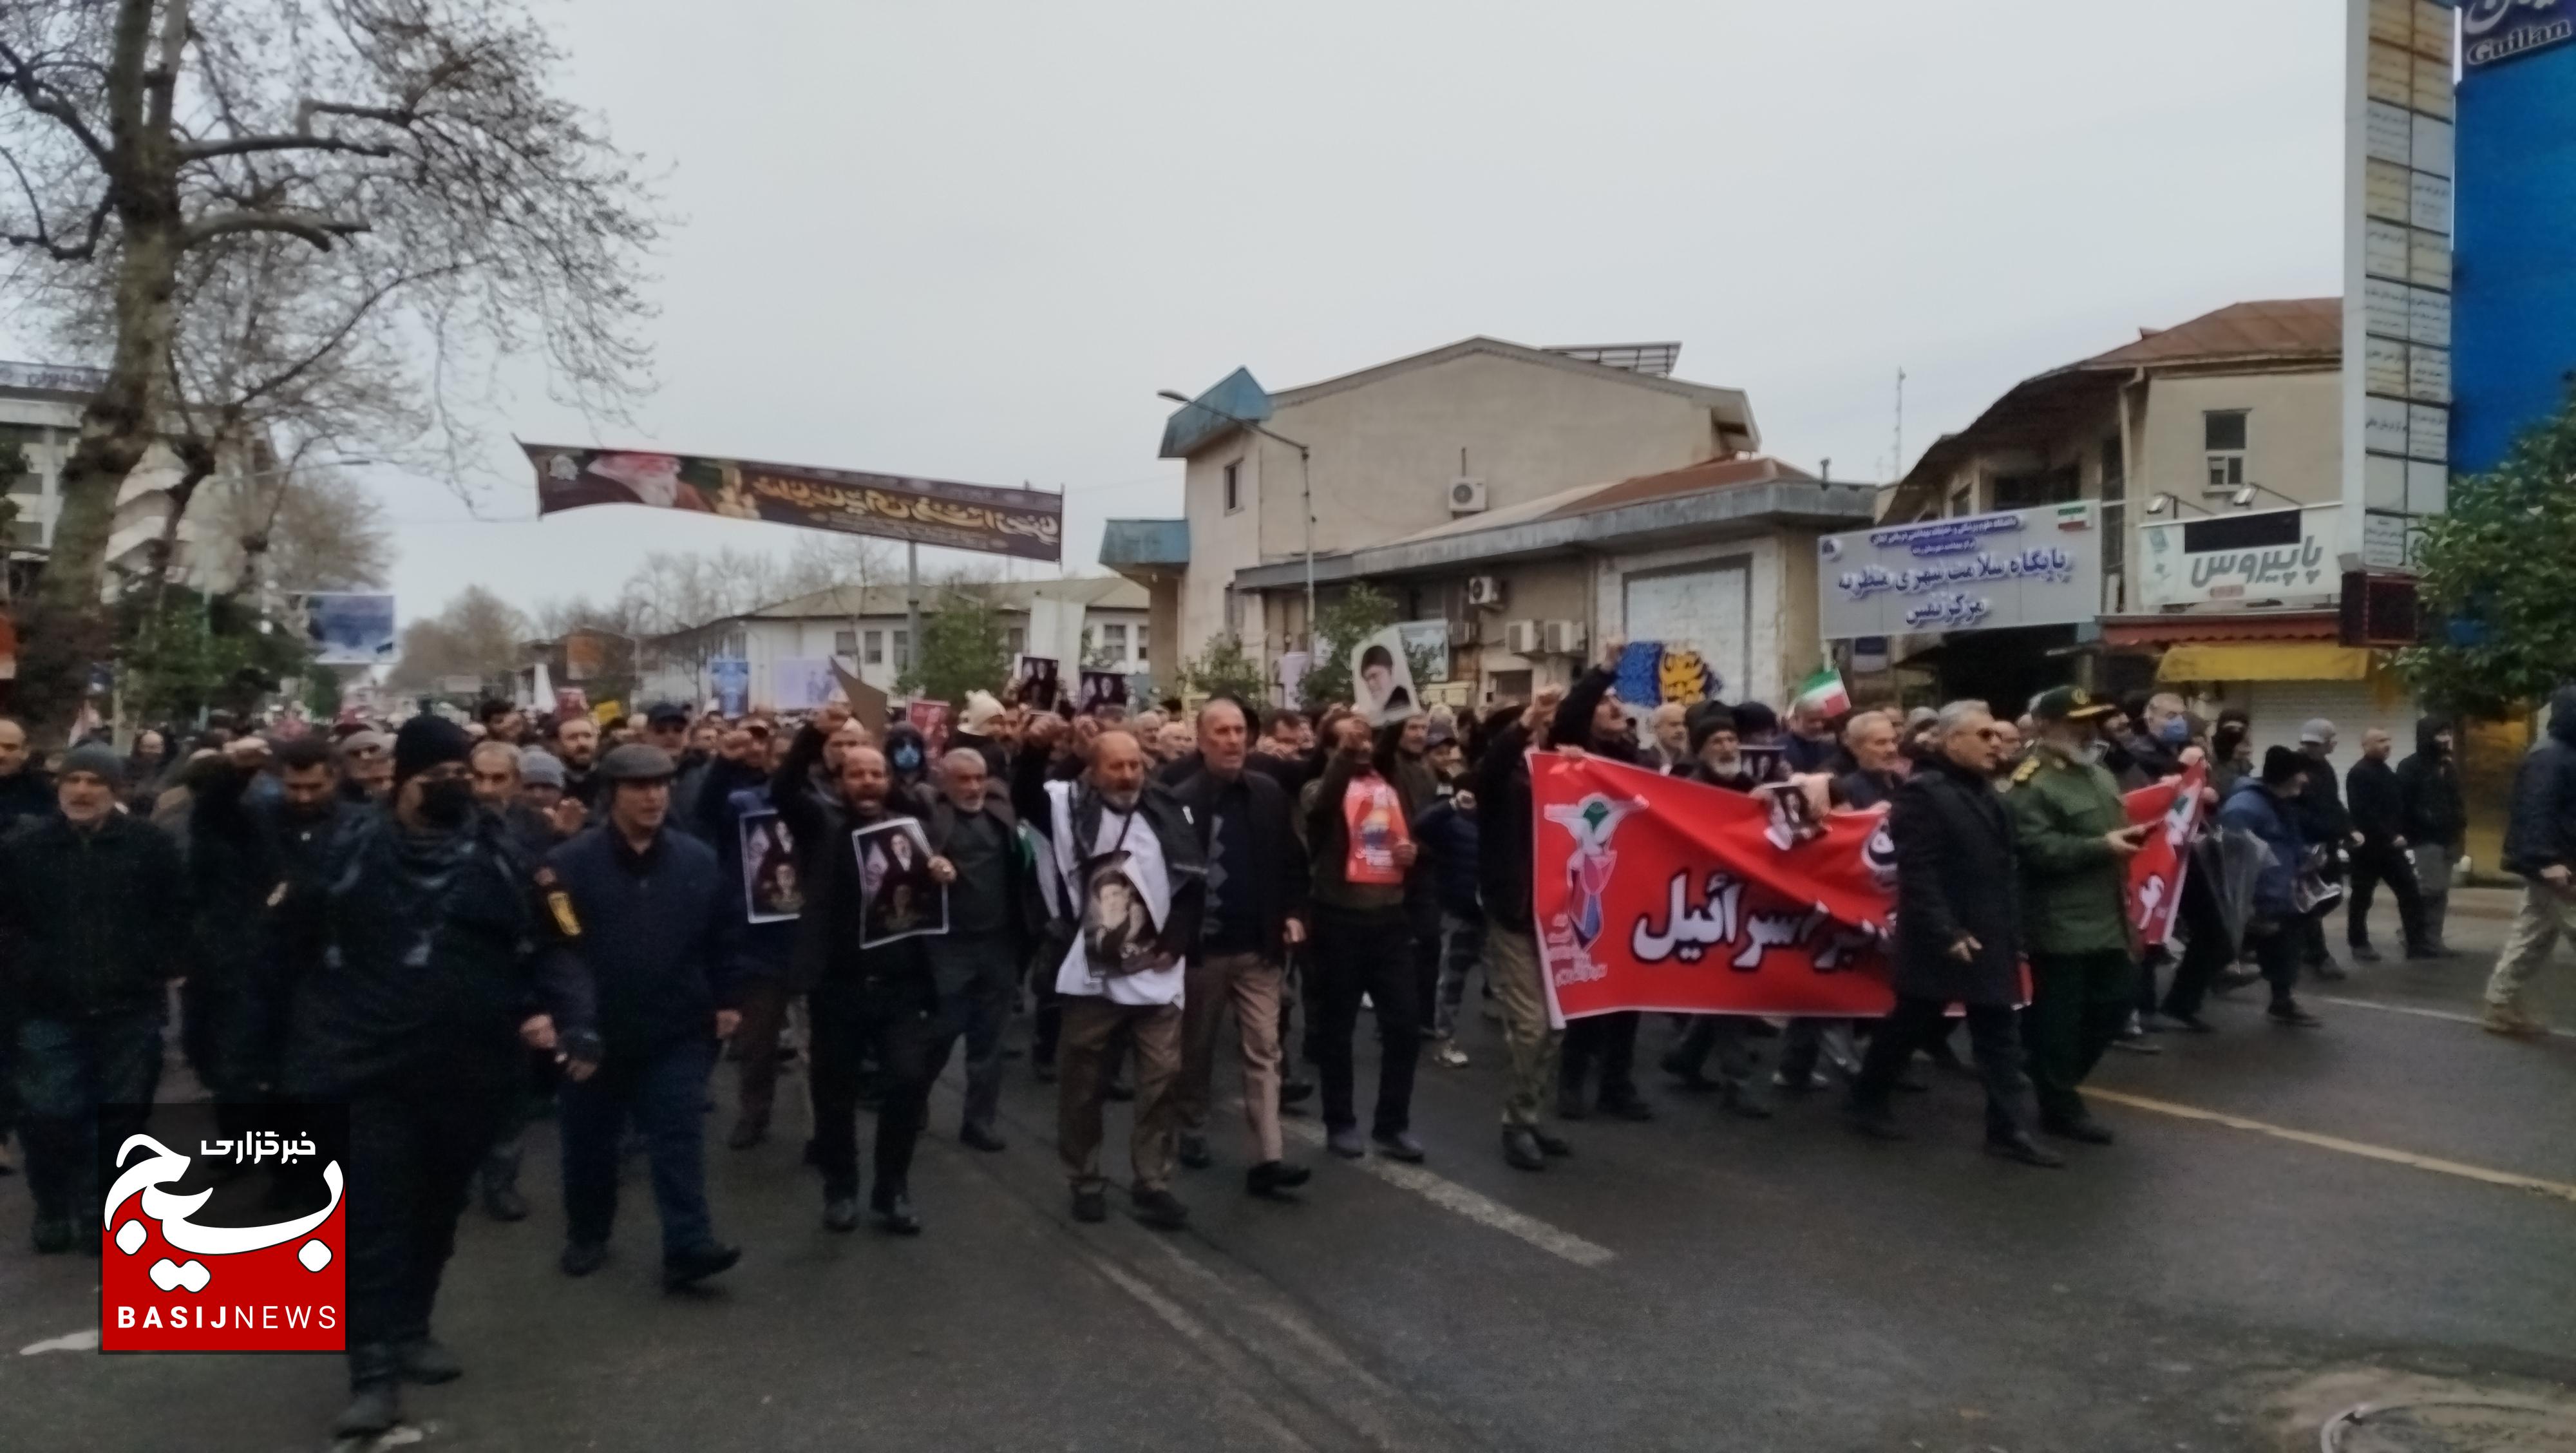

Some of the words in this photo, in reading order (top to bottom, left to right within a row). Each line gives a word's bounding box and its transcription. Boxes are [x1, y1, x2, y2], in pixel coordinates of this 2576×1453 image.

[2467, 18, 2572, 65] Guilan
[1947, 553, 2005, 580] سلامت
[2009, 549, 2072, 584] پایگاه
[2191, 535, 2323, 589] پاپیروس
